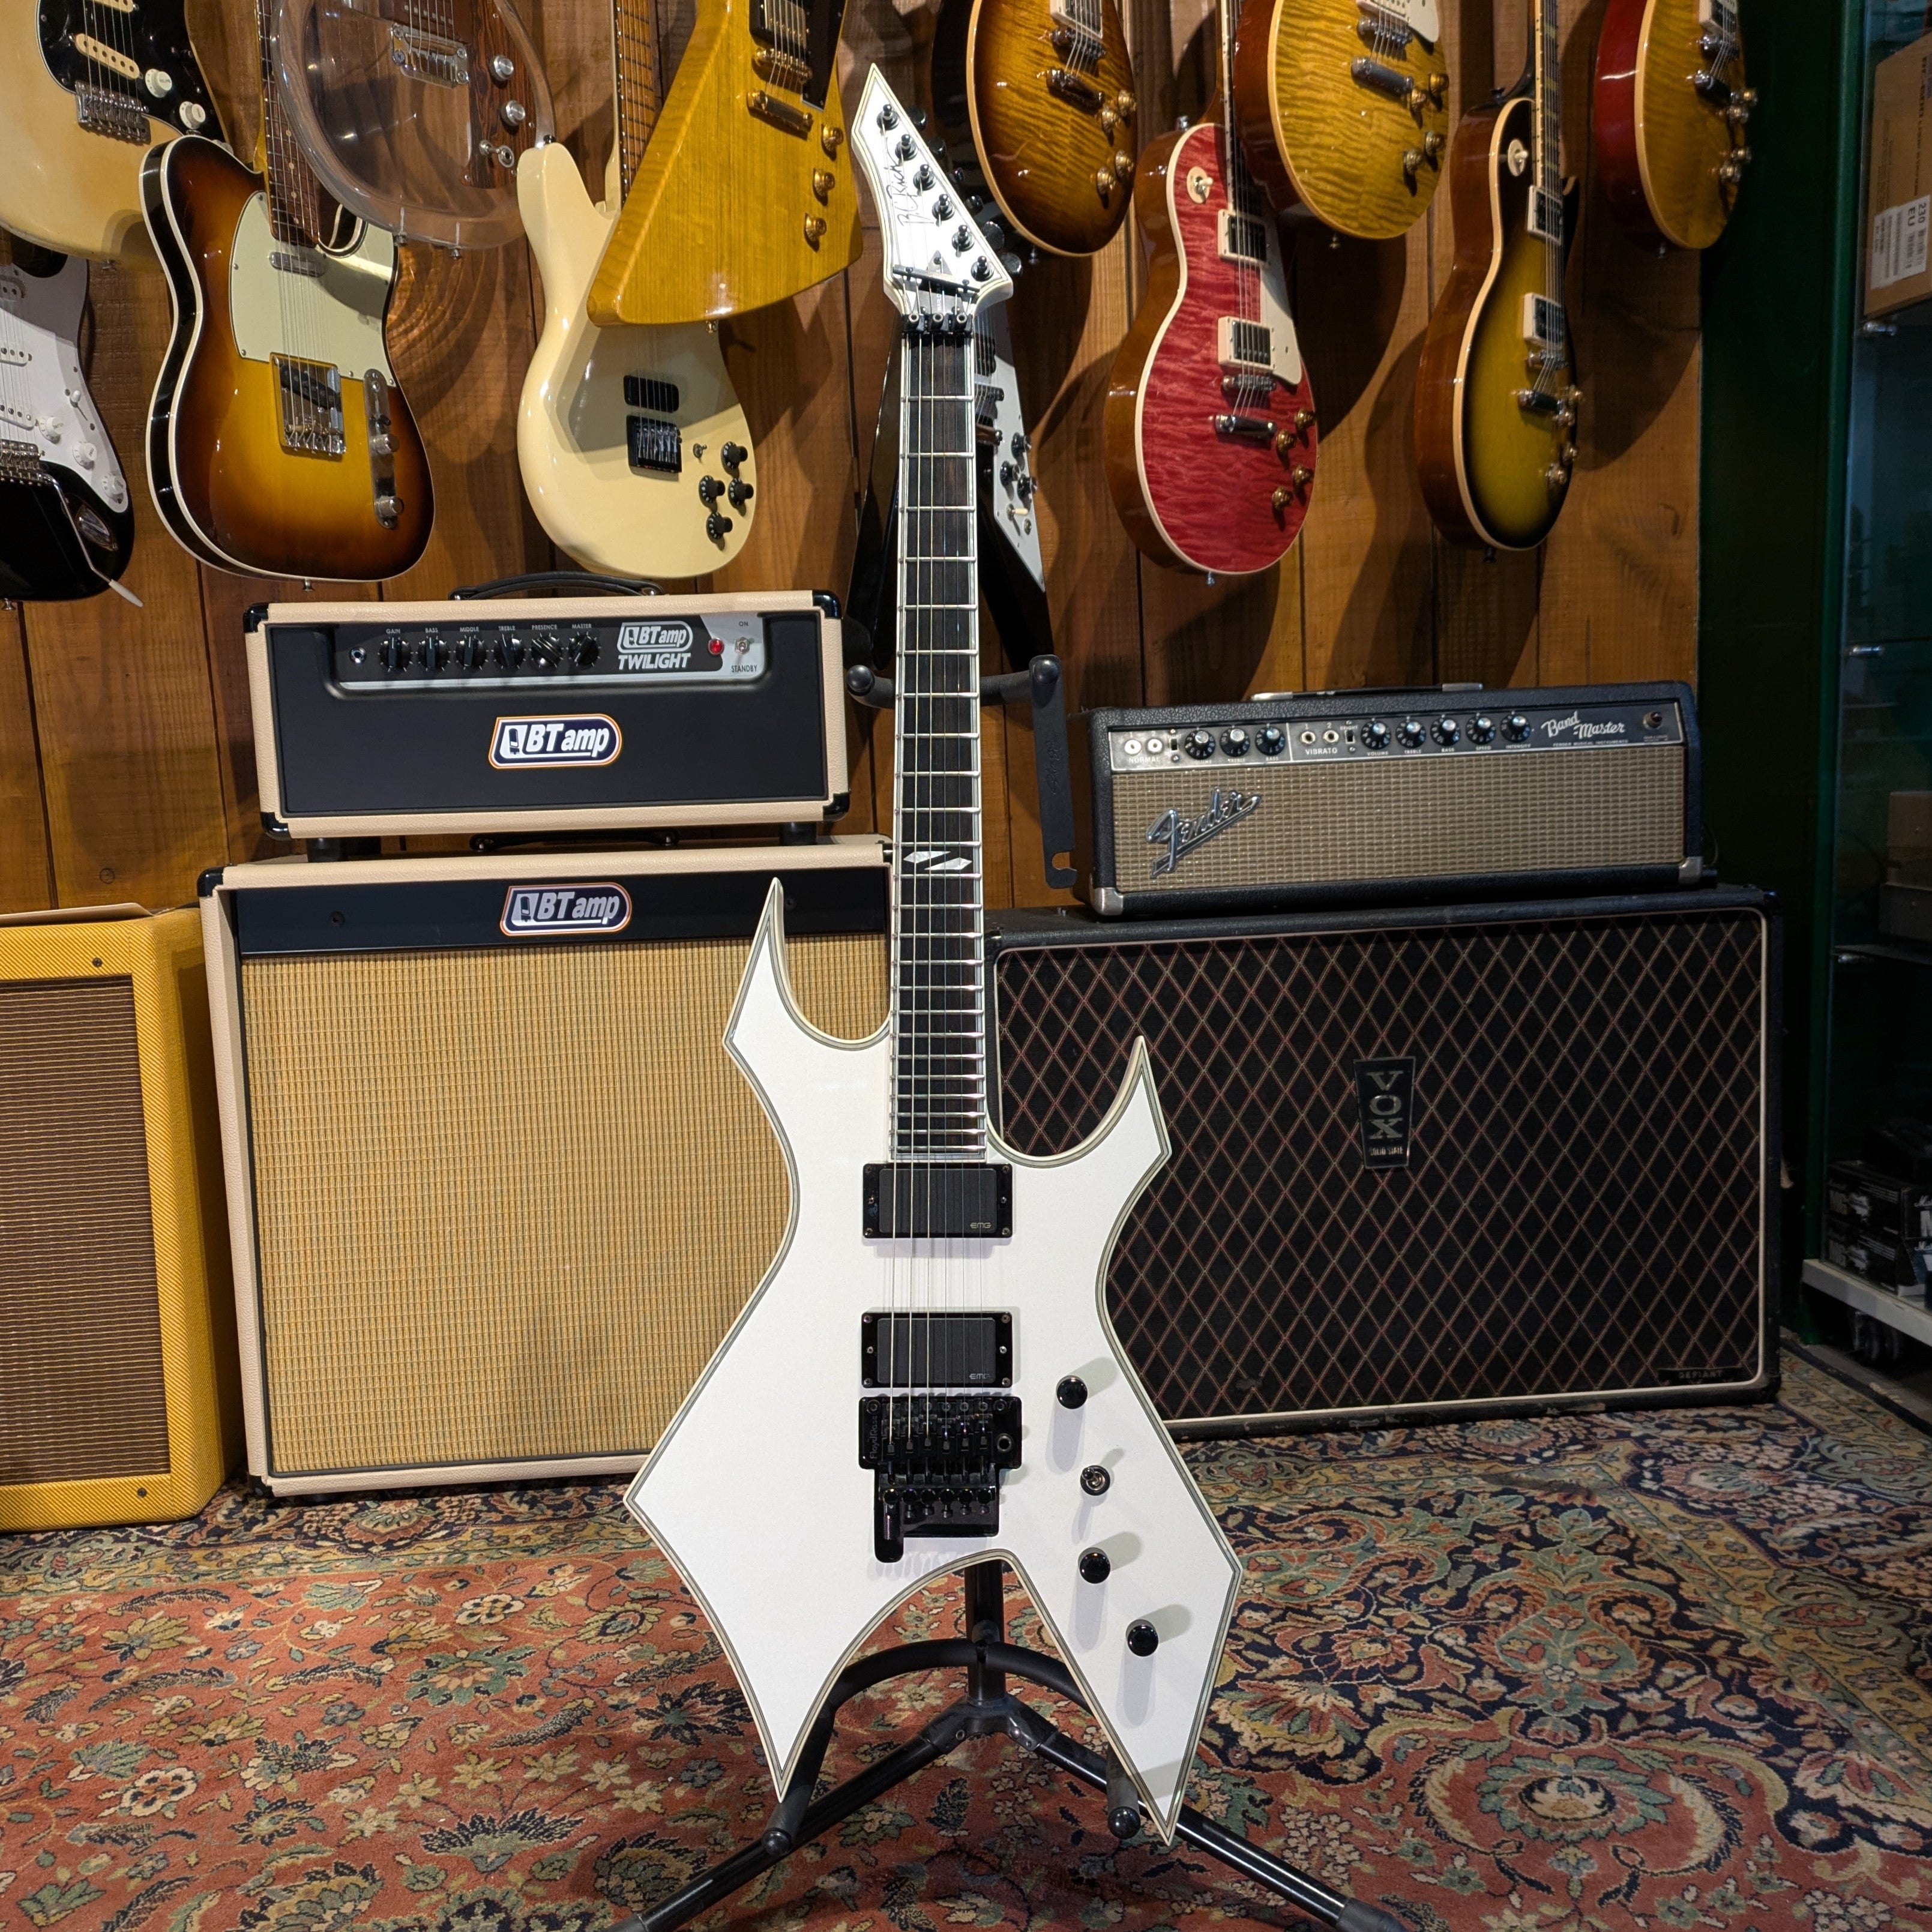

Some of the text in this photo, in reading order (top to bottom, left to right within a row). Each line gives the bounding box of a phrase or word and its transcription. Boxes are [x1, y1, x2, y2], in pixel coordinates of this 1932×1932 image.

[1907, 207, 1916, 226] EU
[1917, 202, 1927, 224] 230
[618, 652, 691, 670] TWILIGHT
[731, 664, 757, 673] STANDBY
[1541, 711, 1581, 738] Band
[1128, 756, 1160, 764] NORMAL
[1146, 786, 1262, 877] Fender
[1365, 1070, 1403, 1140] VOX
[1369, 1146, 1403, 1156] SOLID STATE
[869, 1436, 880, 1459] Floyd
